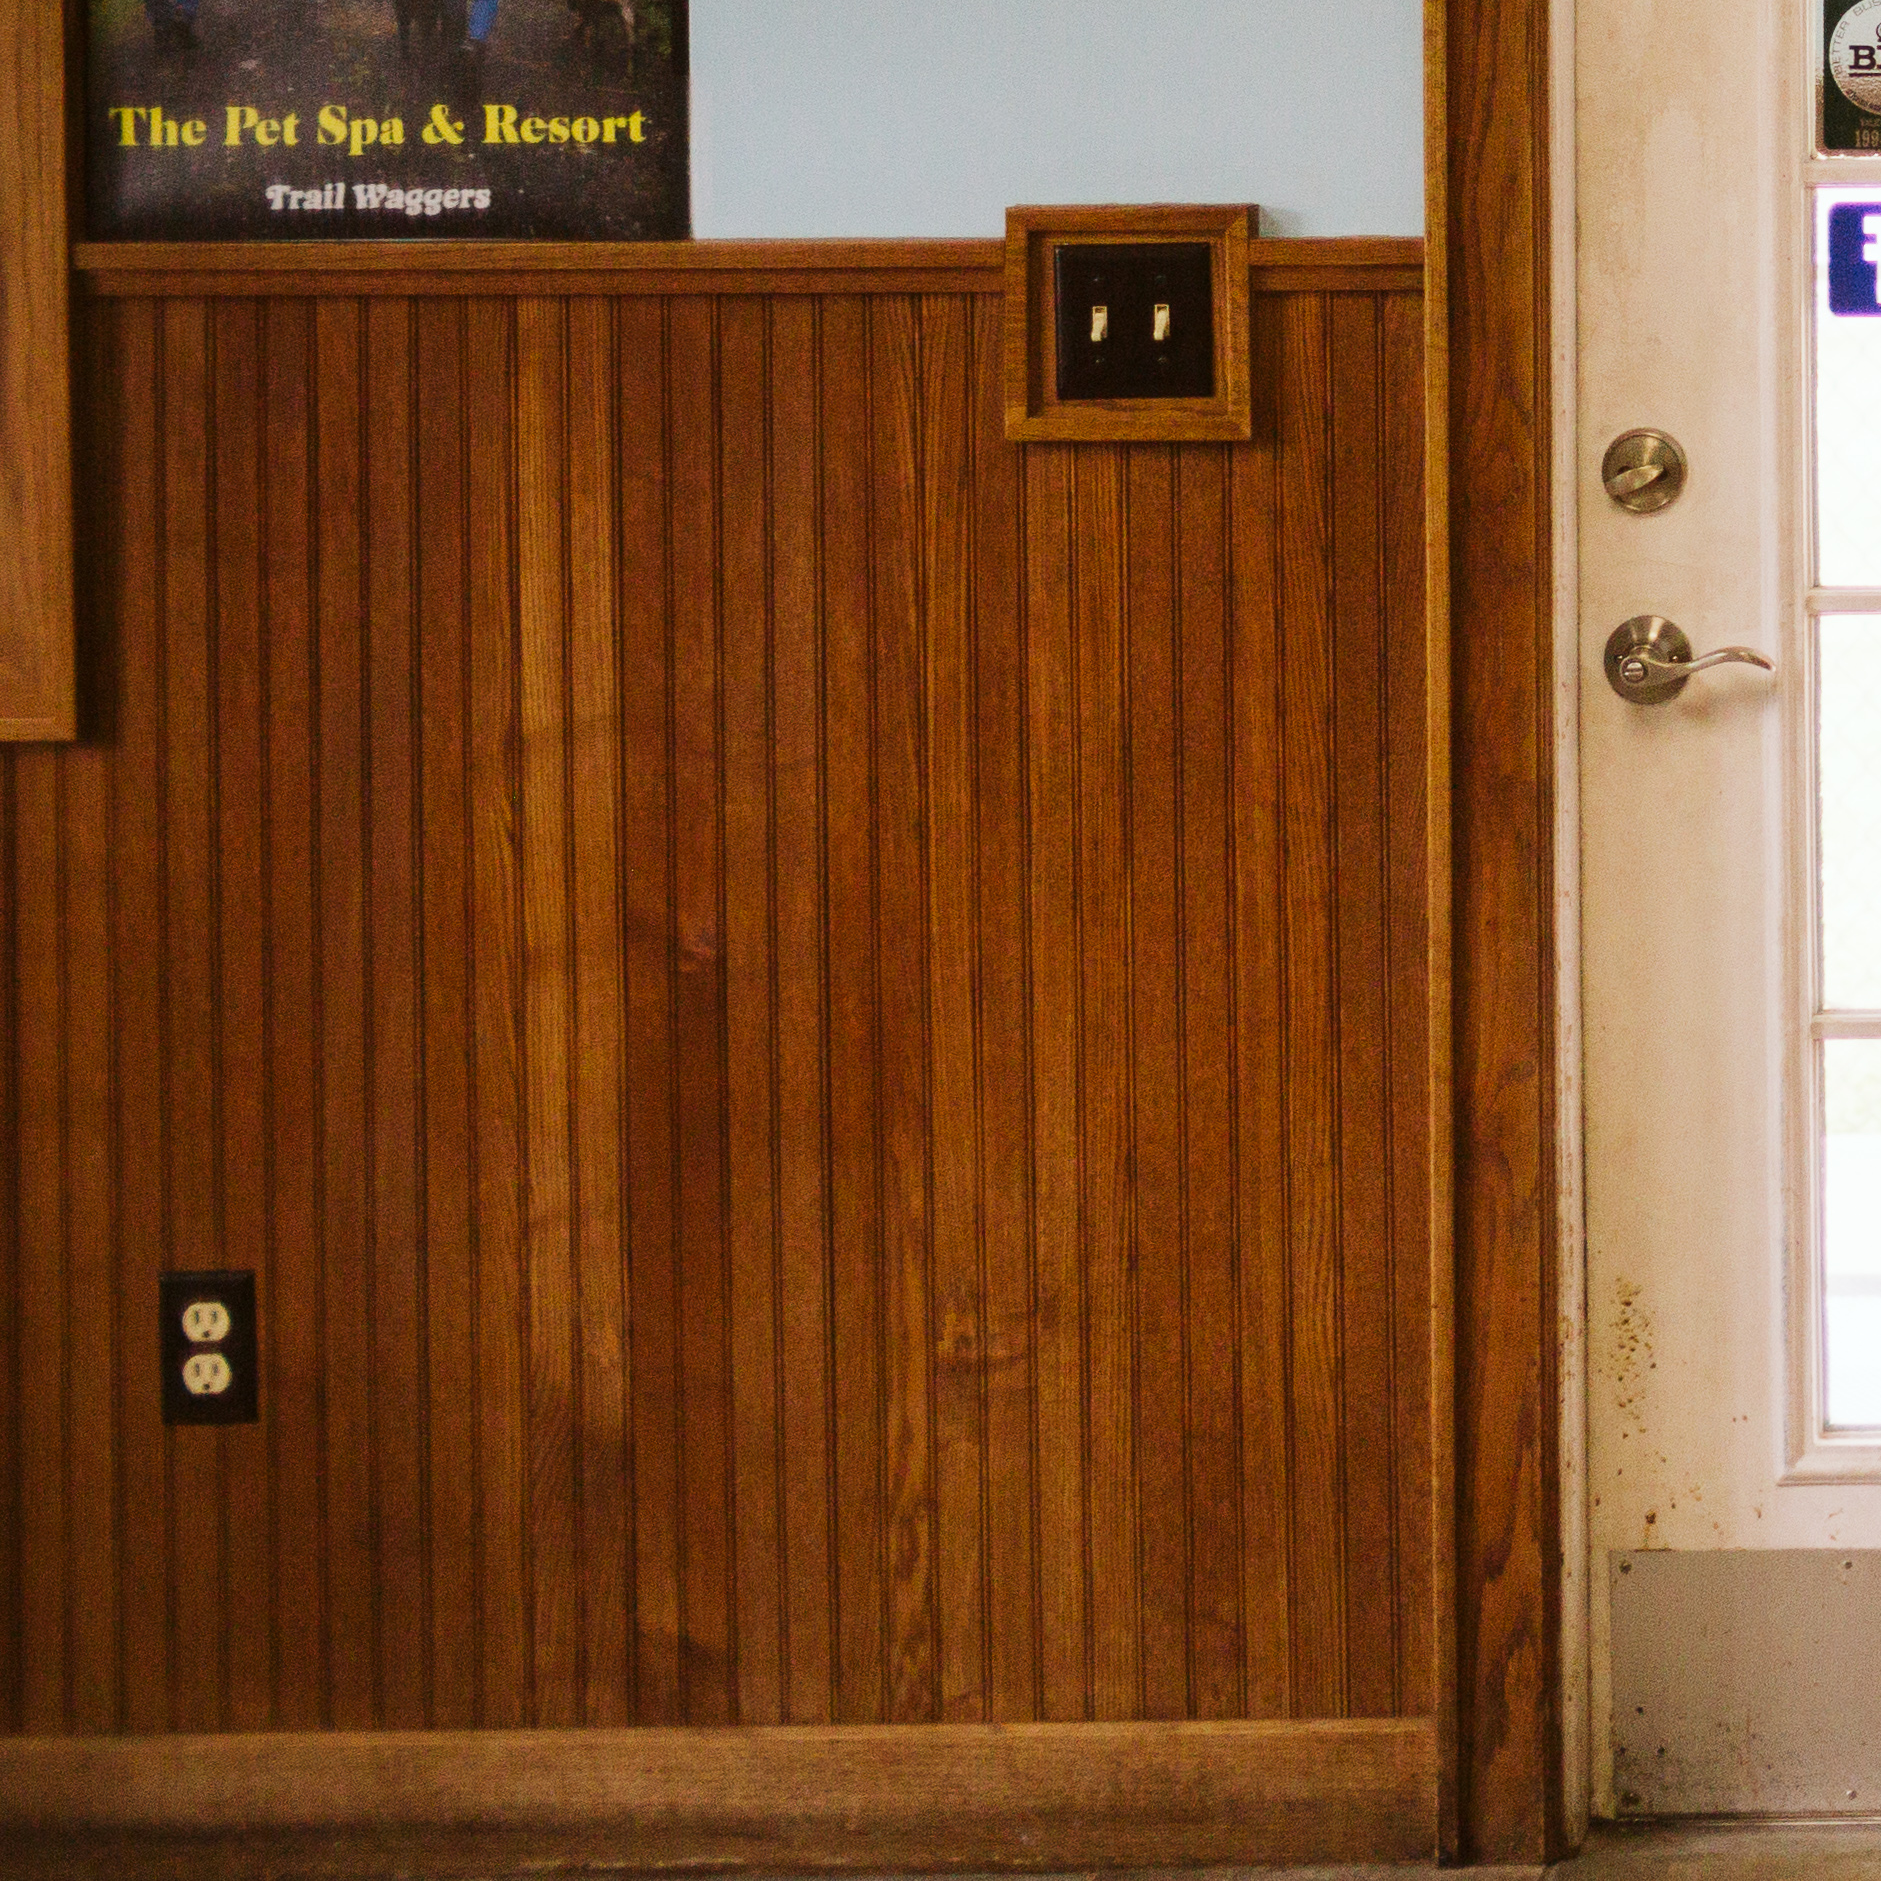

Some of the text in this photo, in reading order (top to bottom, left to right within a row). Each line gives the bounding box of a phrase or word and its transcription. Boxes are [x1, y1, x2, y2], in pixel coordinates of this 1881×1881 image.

[108, 103, 648, 157] The Pet Spa & Resort
[265, 182, 492, 218] Trail Waggers
